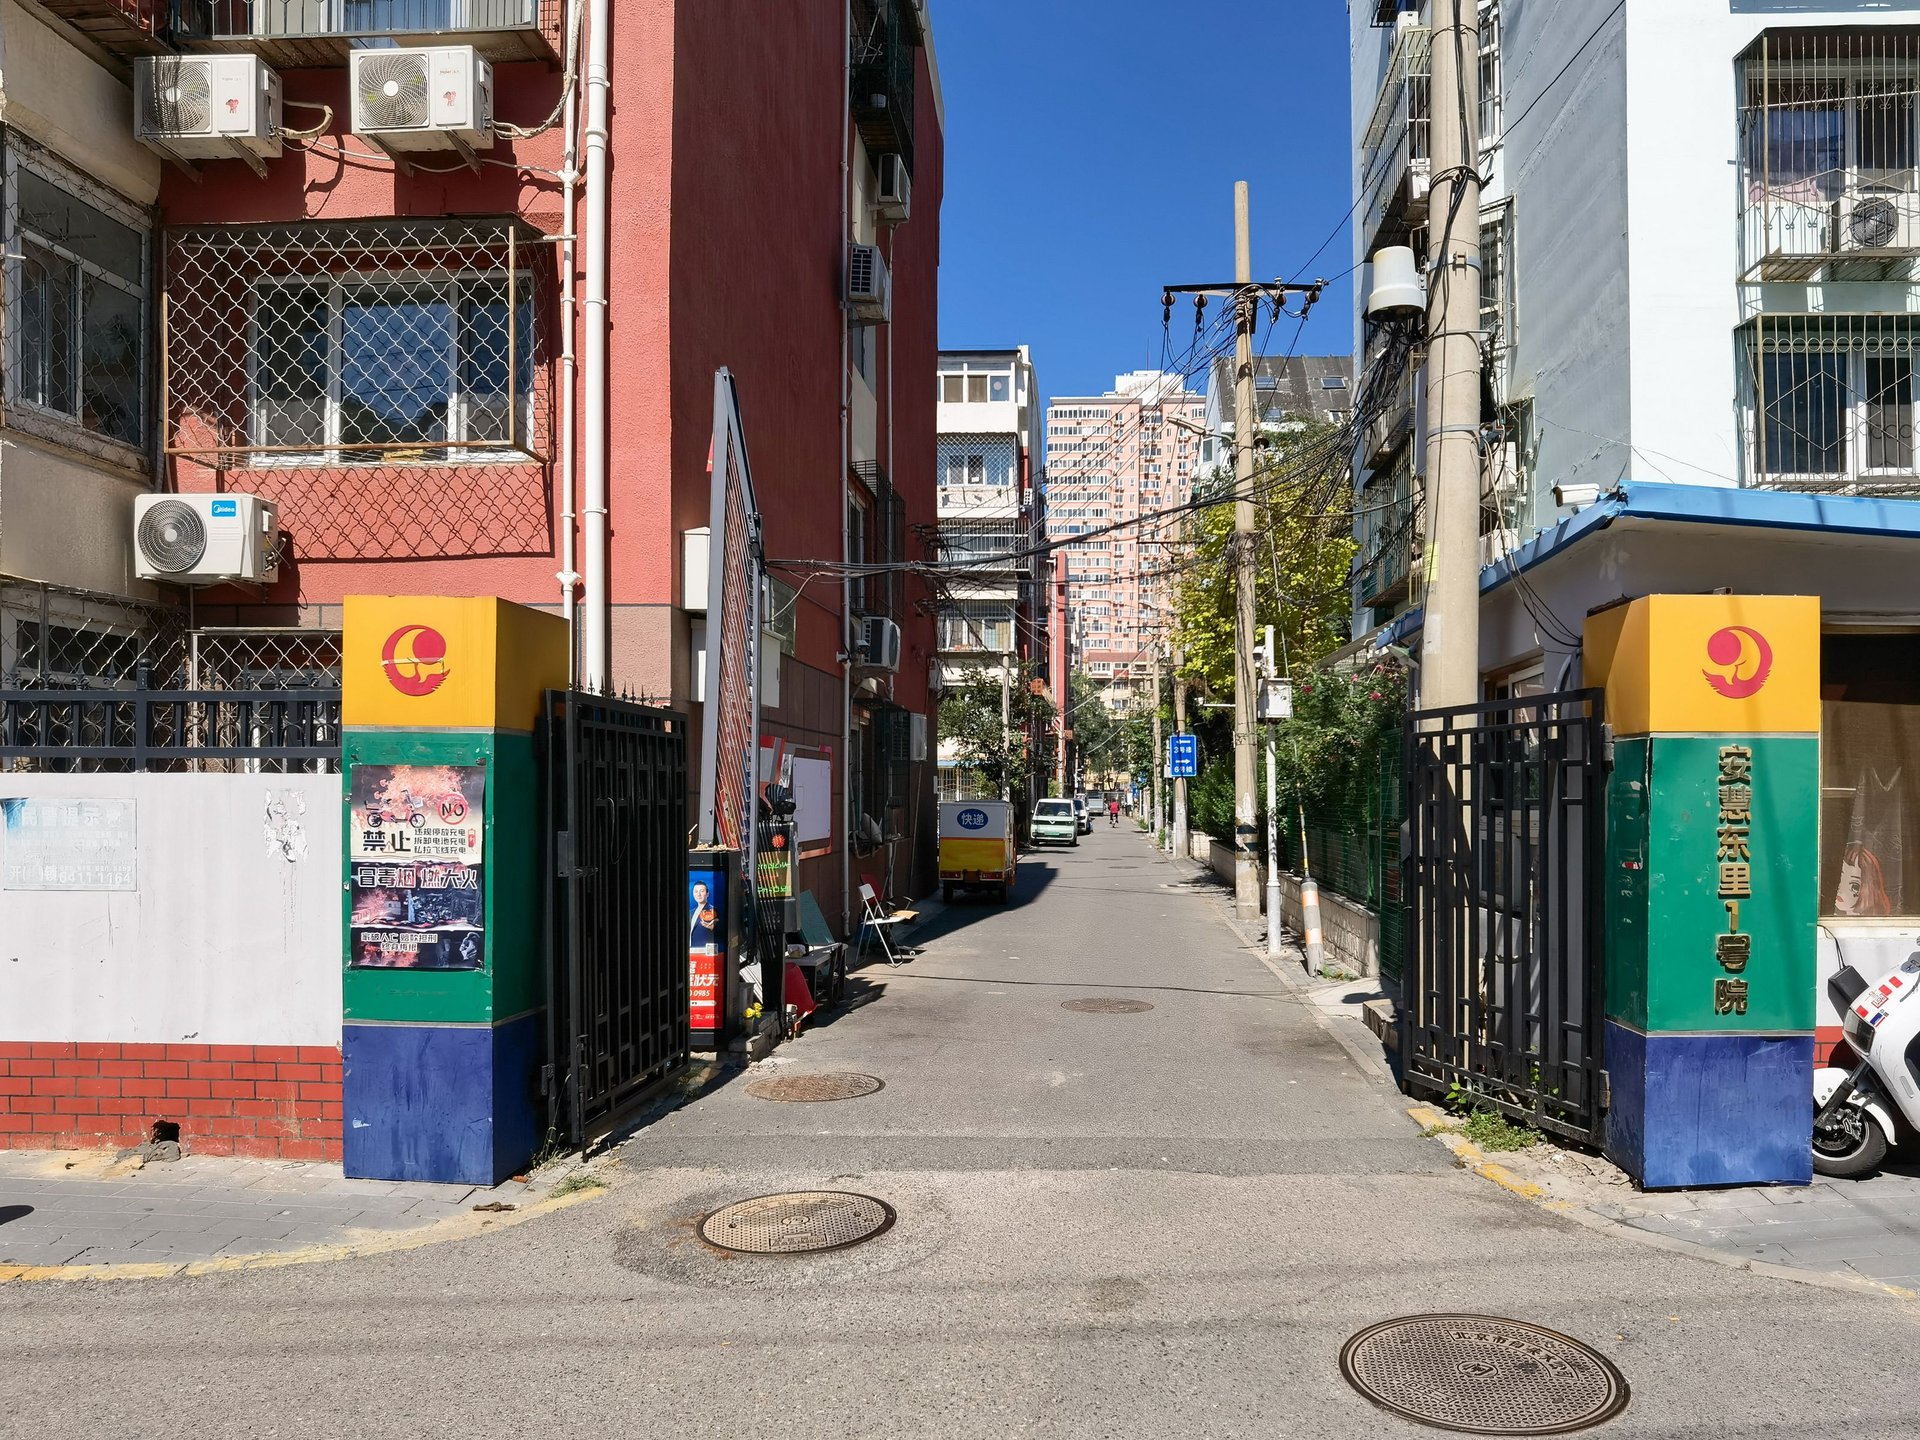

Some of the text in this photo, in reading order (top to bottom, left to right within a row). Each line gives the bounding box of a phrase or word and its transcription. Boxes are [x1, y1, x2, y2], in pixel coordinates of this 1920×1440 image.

[213, 504, 235, 513] Midea
[441, 802, 465, 817] NO
[961, 813, 985, 826] 快递
[414, 827, 466, 836] 违规停放充电
[363, 830, 411, 852] 禁止
[414, 837, 466, 845] 拆卸电池充电
[414, 846, 466, 854] 私拉飞线充电
[358, 867, 478, 889] 冒毒烟 燃大火
[1714, 744, 1752, 1016] 安慧东里1号院
[693, 989, 711, 997] 0985
